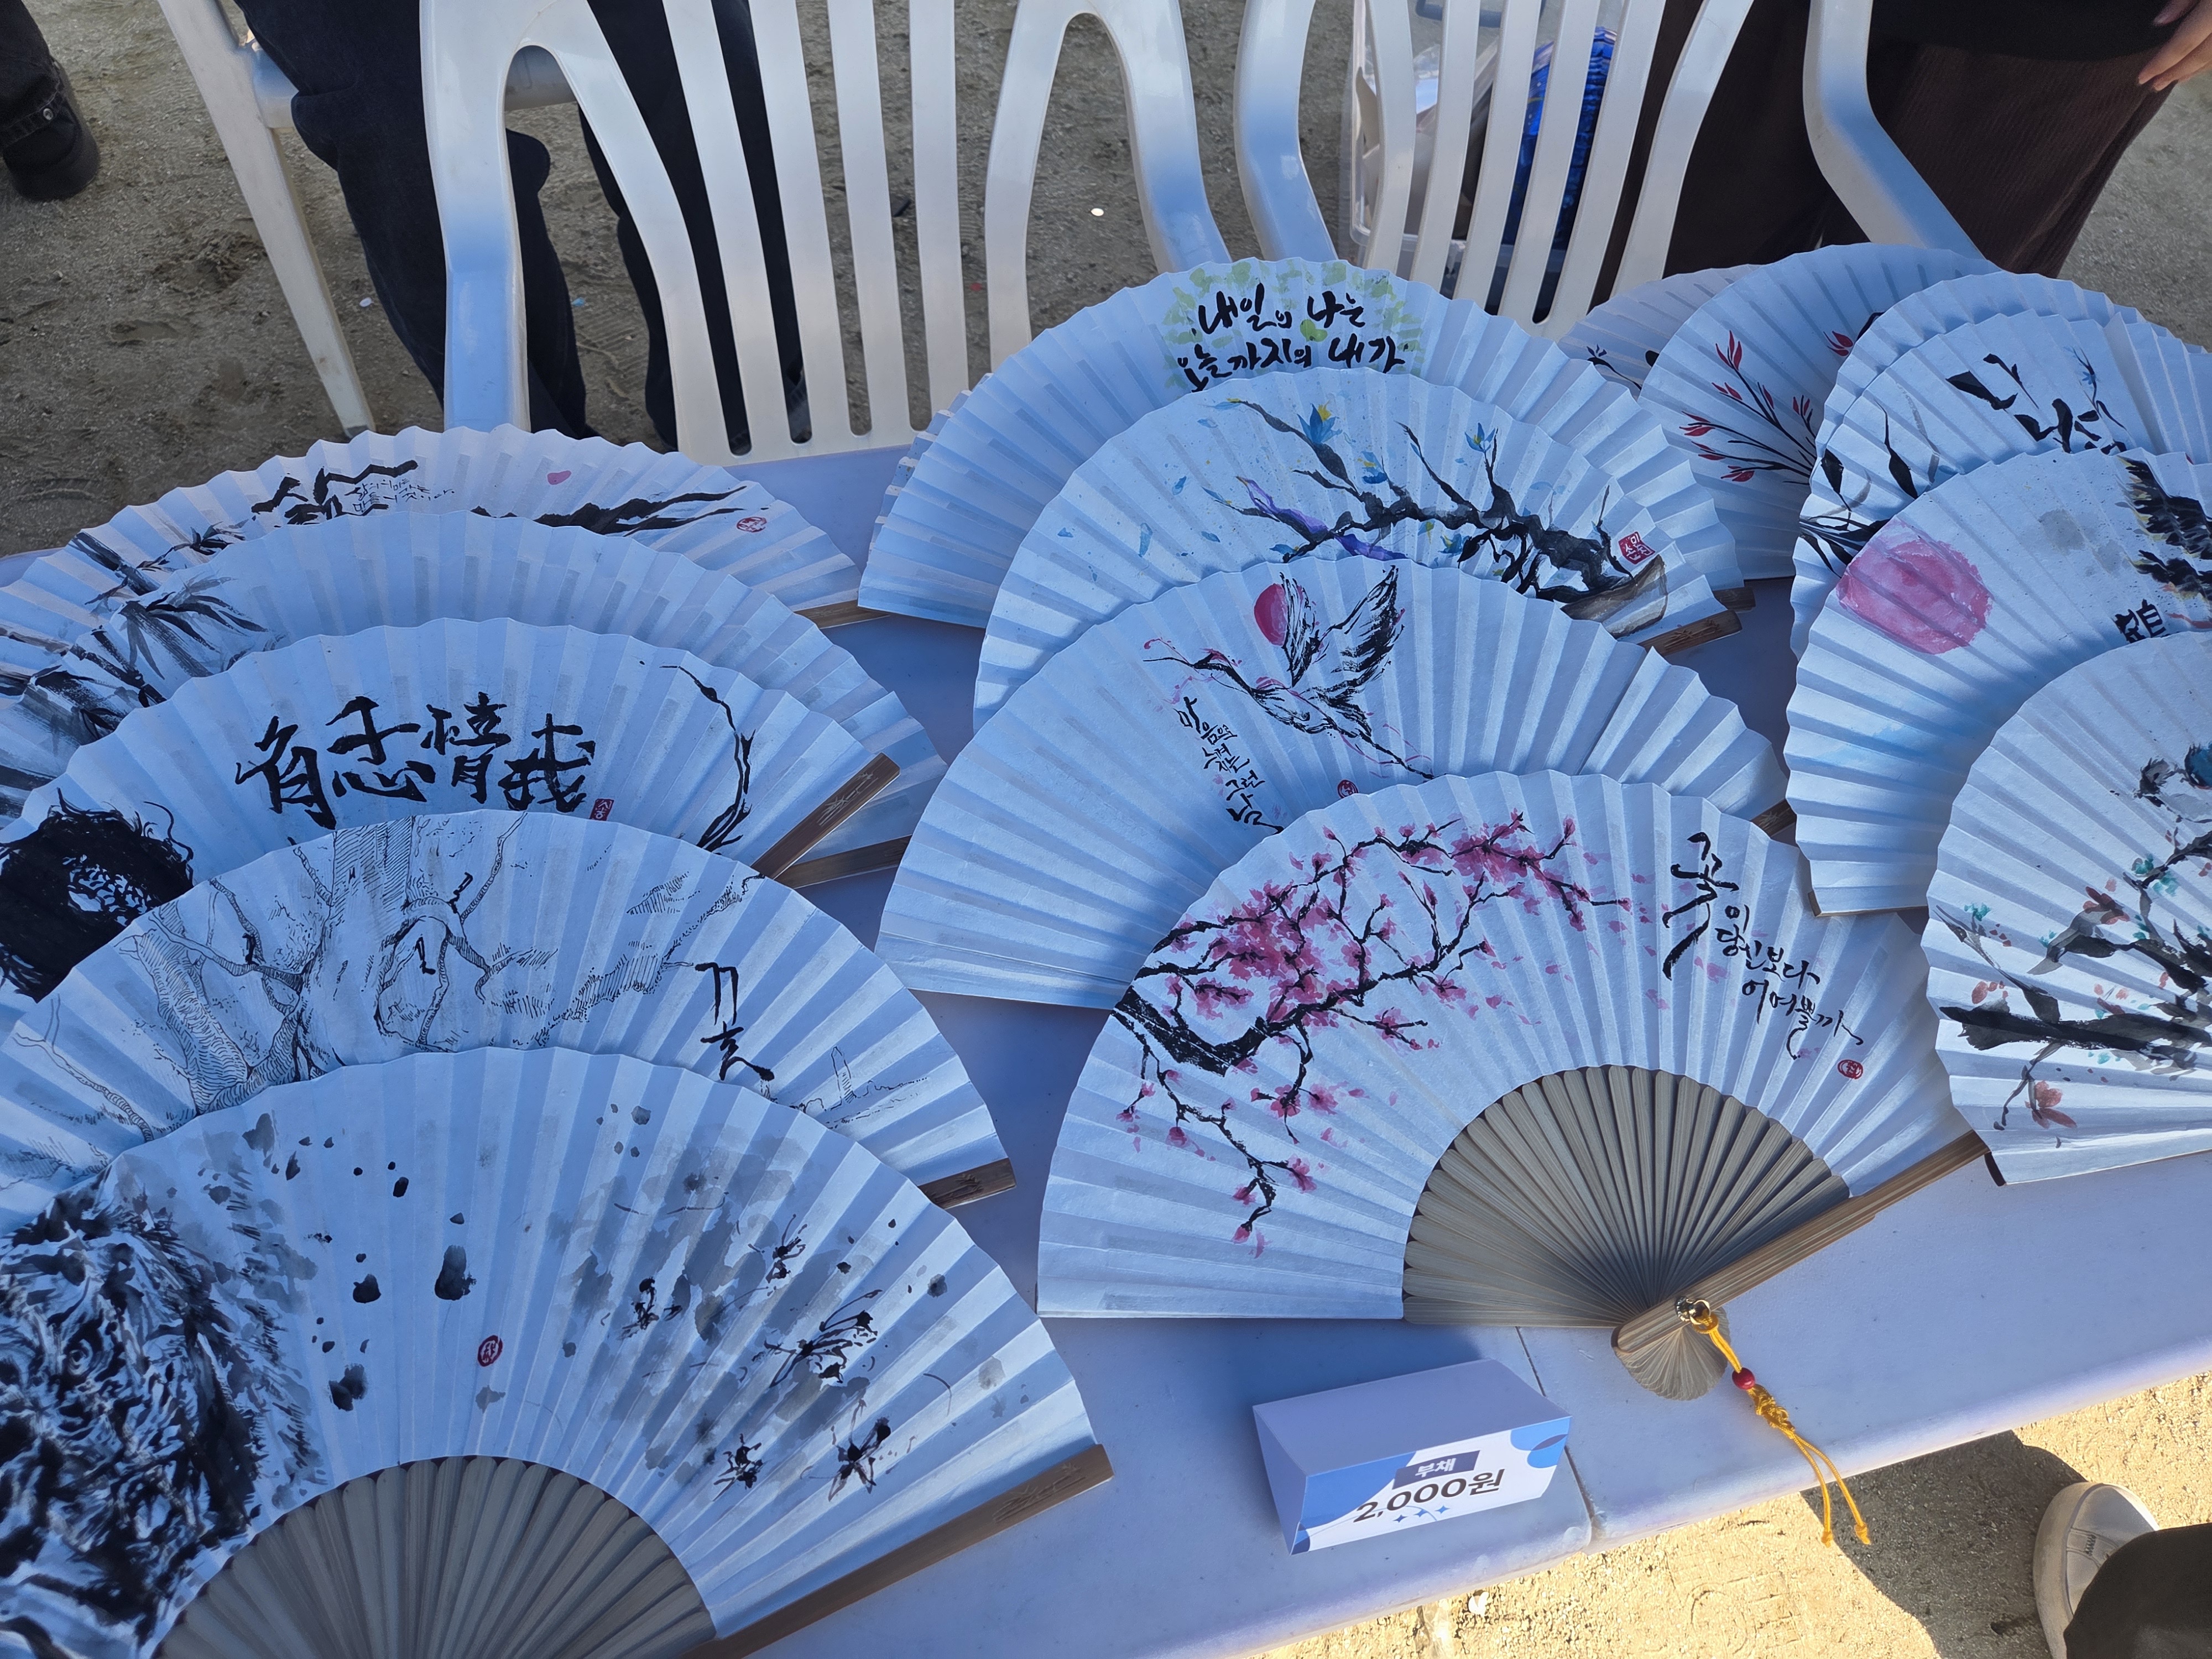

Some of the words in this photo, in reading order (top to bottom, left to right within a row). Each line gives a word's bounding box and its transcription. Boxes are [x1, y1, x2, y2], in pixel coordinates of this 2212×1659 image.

[1198, 282, 1292, 335] 내일의
[1306, 290, 1366, 328] 나는
[1328, 333, 1406, 374] 내가
[1225, 769, 1266, 801] 그런
[1415, 1457, 1457, 1478] 부채
[1353, 1468, 1506, 1524] 2,000원
